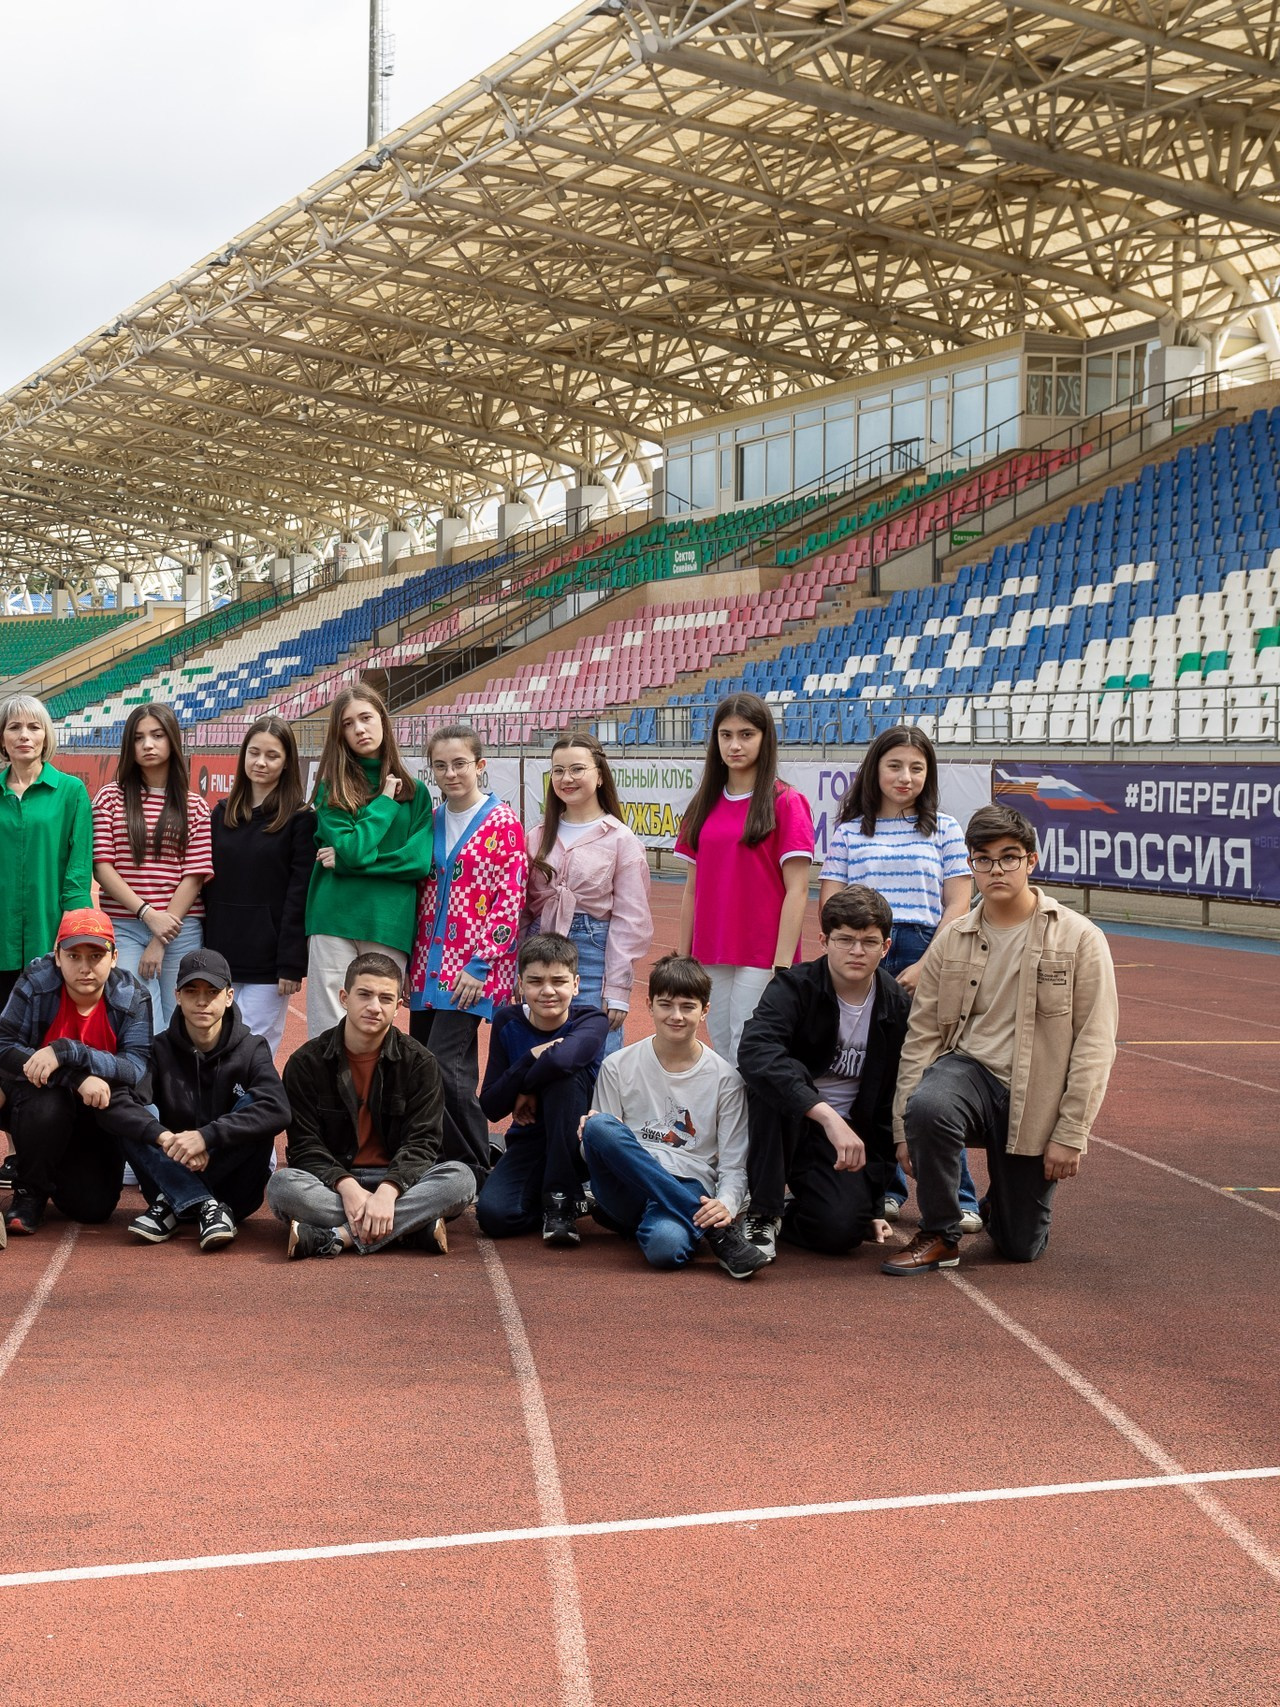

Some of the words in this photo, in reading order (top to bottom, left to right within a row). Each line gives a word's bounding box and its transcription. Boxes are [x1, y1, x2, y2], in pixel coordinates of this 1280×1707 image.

[674, 550, 695, 563] Сектор
[661, 768, 693, 789] КЛУБ
[1033, 827, 1252, 889] МЫРОССИЯ
